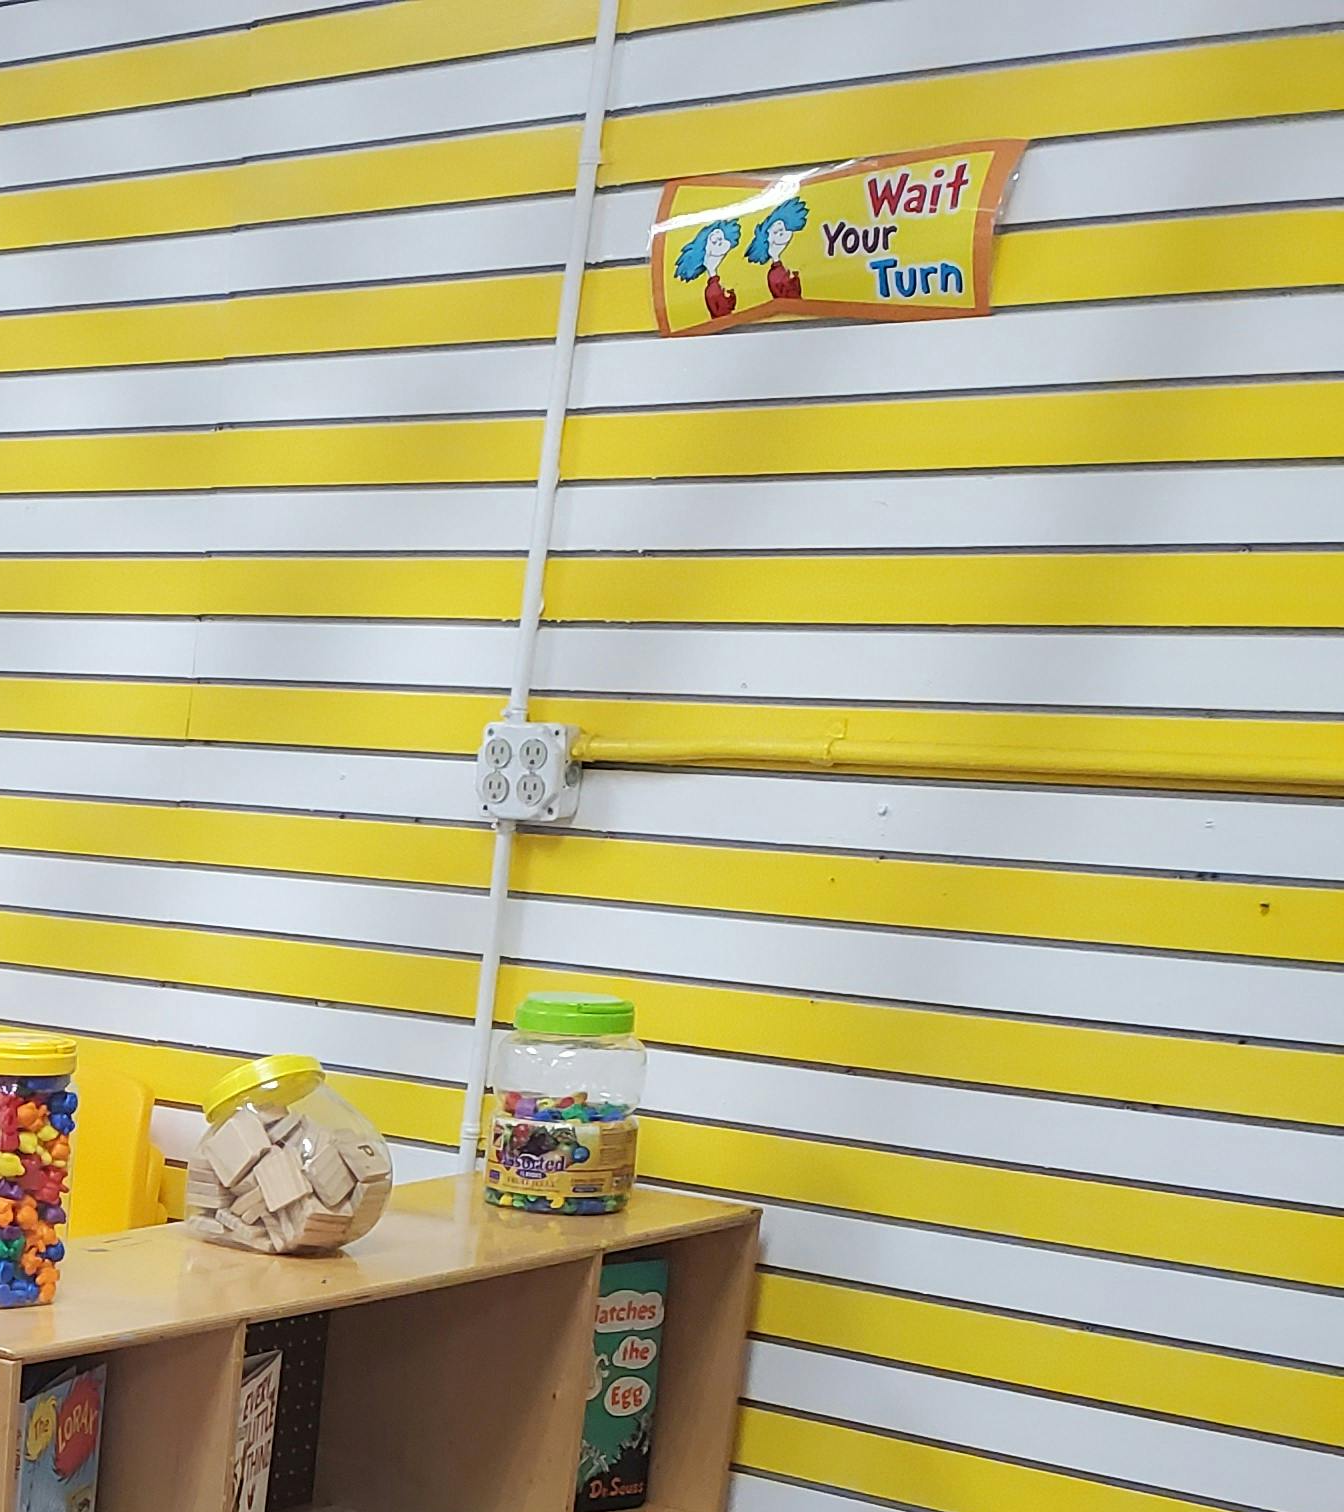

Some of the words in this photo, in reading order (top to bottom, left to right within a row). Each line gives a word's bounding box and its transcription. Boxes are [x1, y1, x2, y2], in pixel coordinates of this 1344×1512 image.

[866, 161, 970, 220] Wait
[821, 220, 899, 258] Your
[869, 257, 966, 299] Turn
[621, 1339, 650, 1362] the
[610, 1385, 644, 1410] Egg
[31, 1416, 50, 1442] The
[56, 1405, 99, 1453] LORAX
